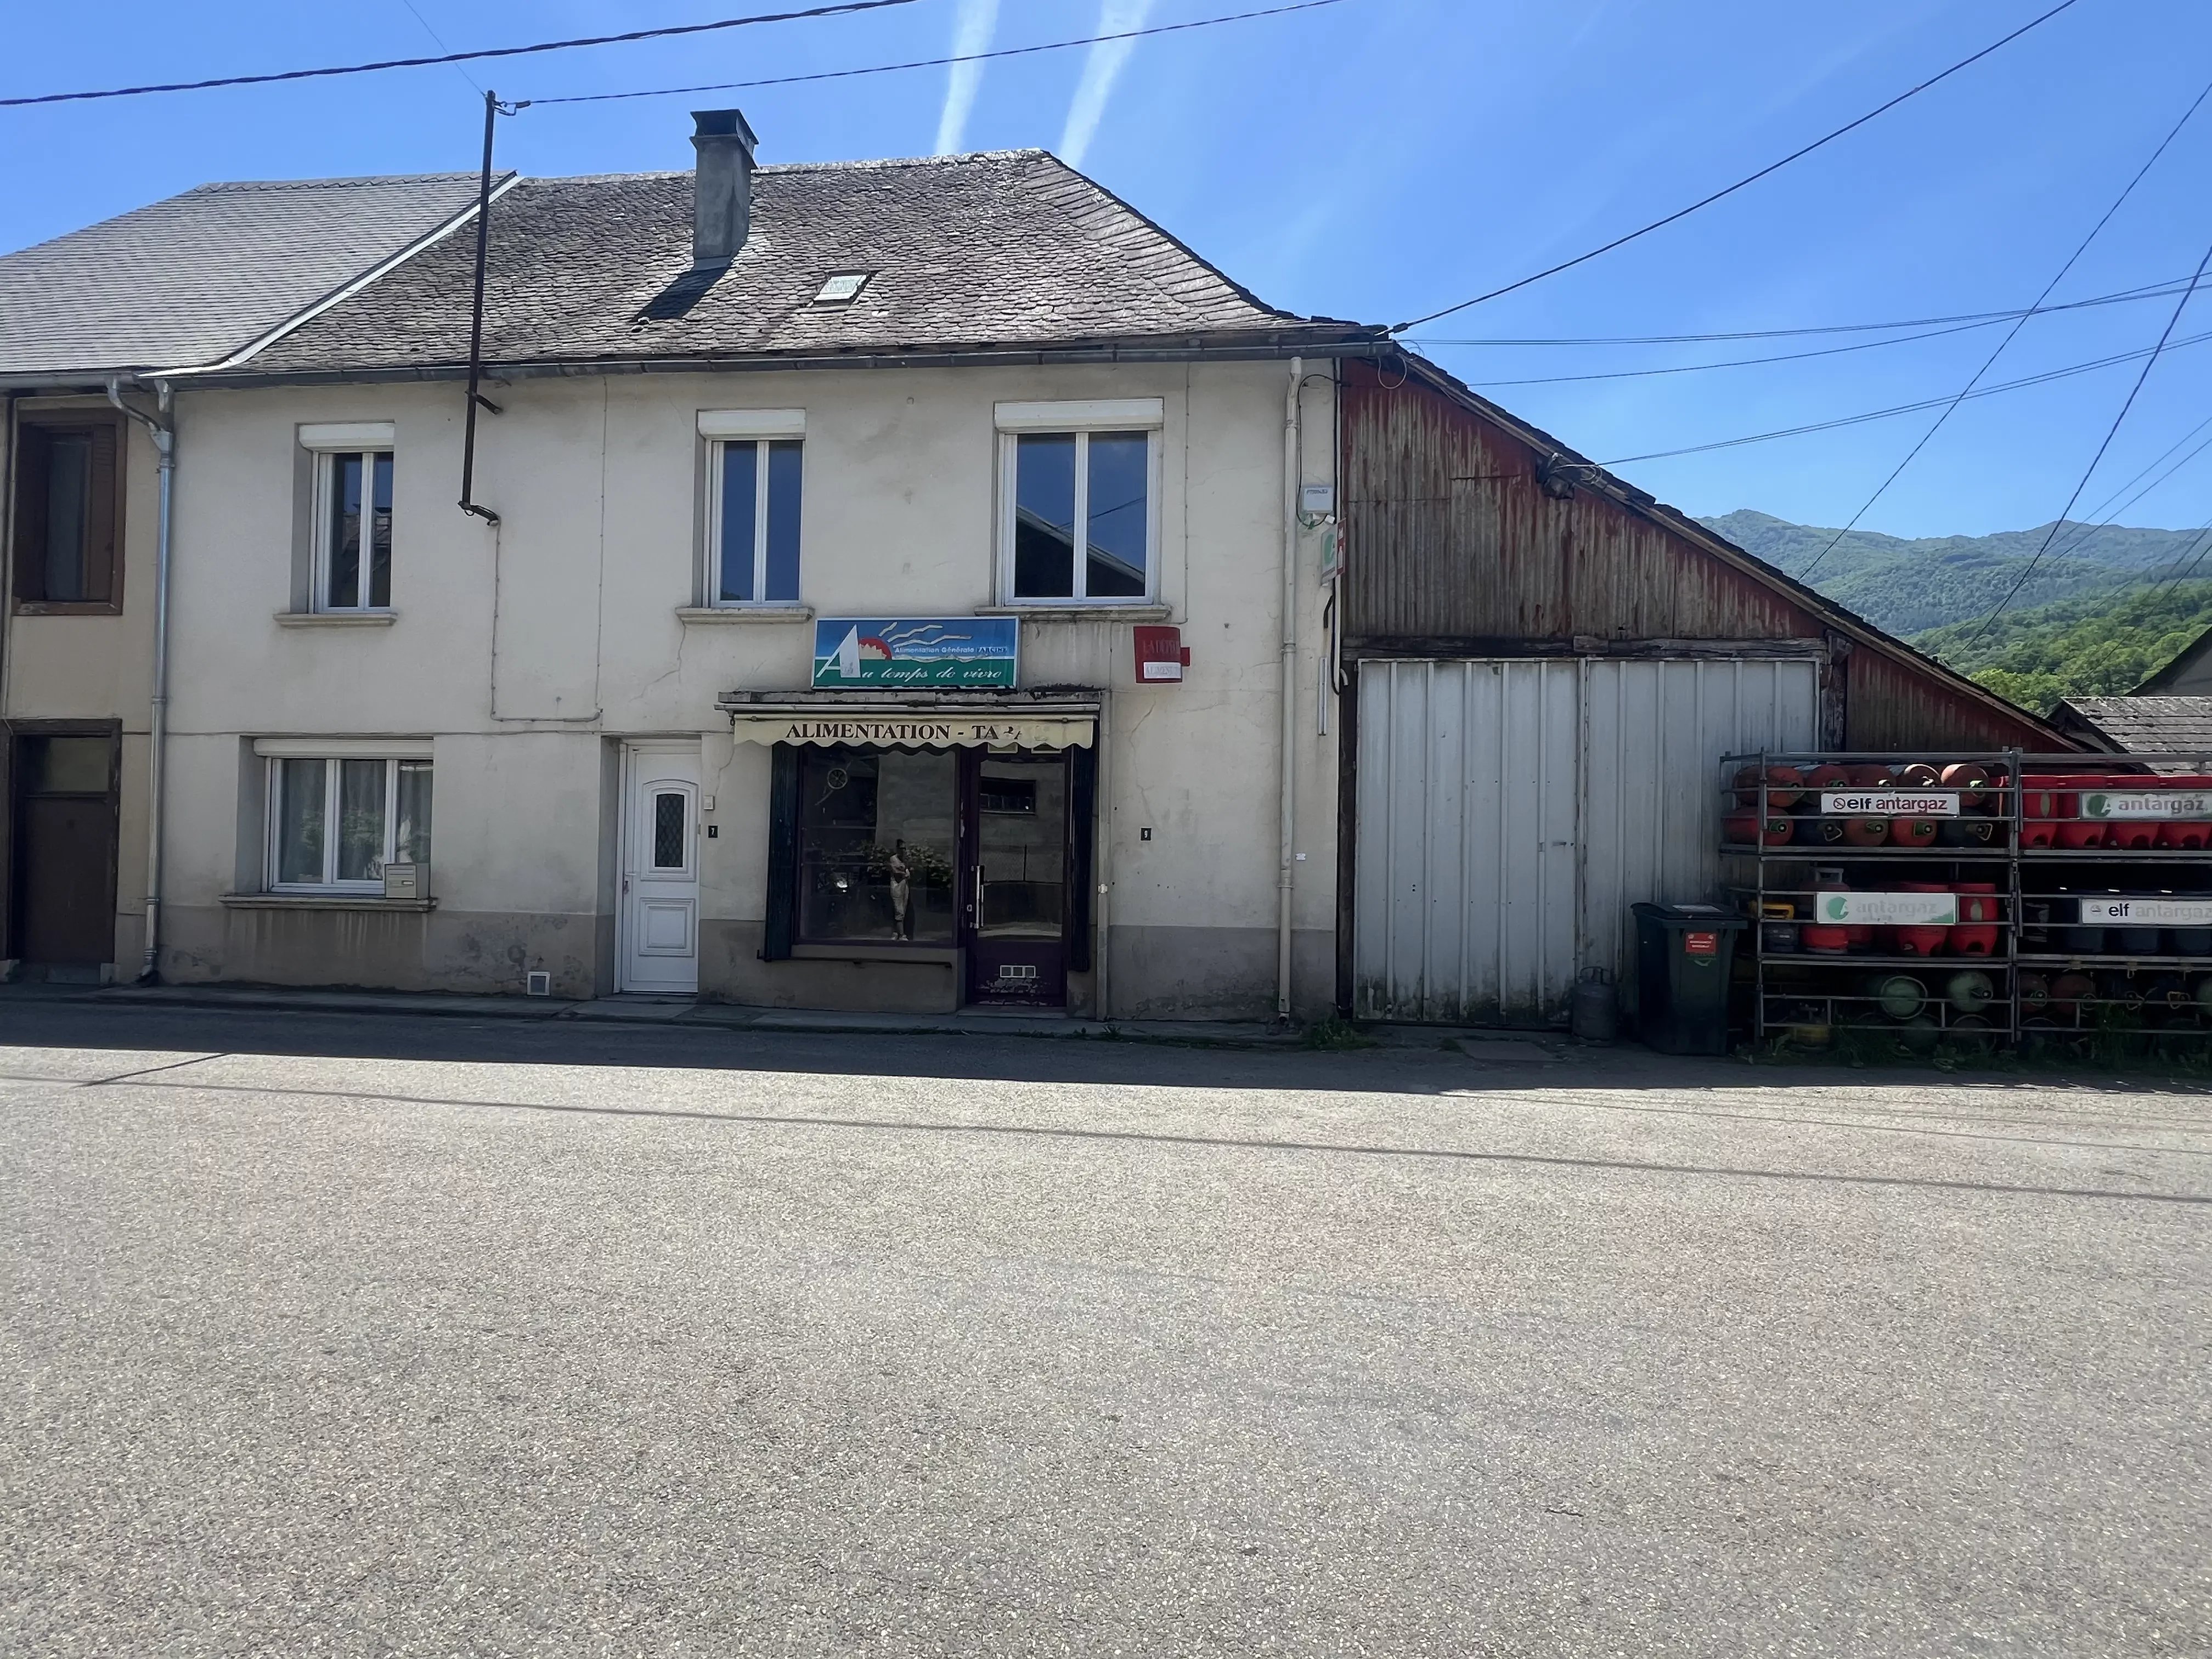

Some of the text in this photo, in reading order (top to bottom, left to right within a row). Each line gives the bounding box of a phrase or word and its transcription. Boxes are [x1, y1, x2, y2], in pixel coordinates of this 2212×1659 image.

[881, 667, 928, 682] temps
[936, 667, 956, 678] de
[963, 668, 1002, 679] vivre
[786, 723, 951, 740] ALIMENTATION
[1847, 797, 1948, 811] elf antargaz
[2118, 798, 2204, 814] antargaz
[1856, 900, 1938, 917] antargaz
[2108, 902, 2212, 921] elf antargaz
